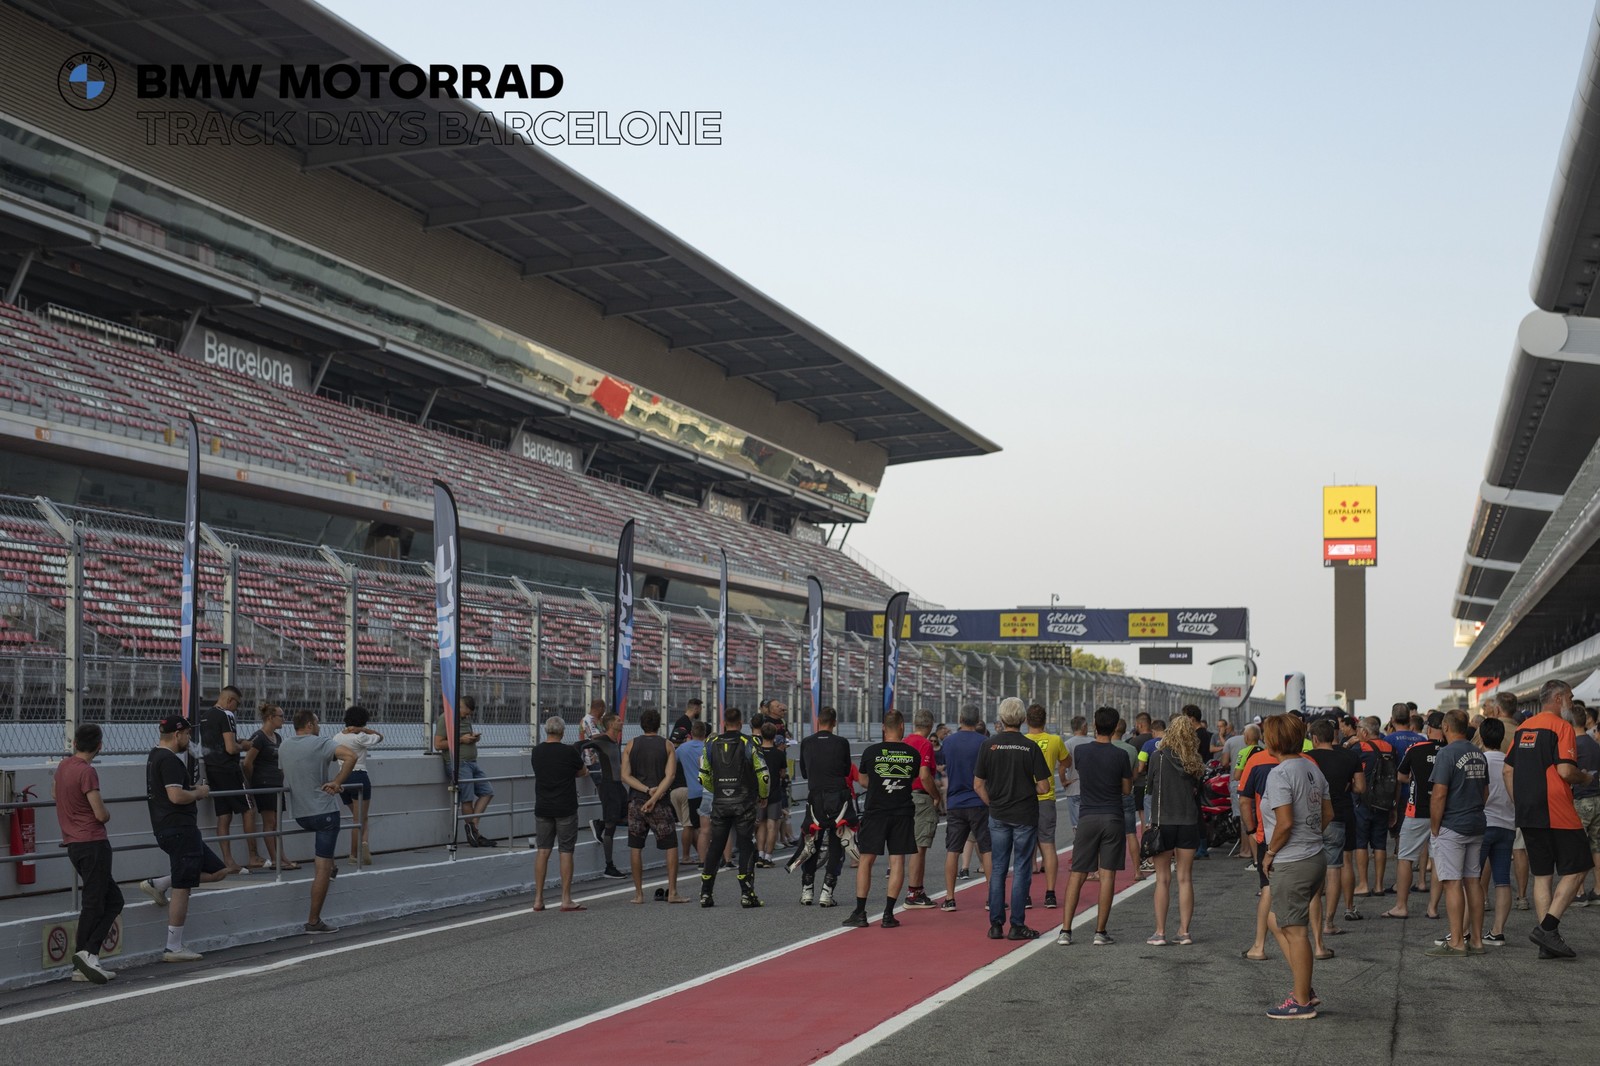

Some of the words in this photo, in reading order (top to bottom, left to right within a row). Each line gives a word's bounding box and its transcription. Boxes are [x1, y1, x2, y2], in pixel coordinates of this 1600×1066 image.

[204, 330, 293, 387] Barcelona
[522, 433, 574, 470] Barcelona
[919, 613, 958, 625] GRAND
[1047, 612, 1087, 624] GRAND
[1177, 612, 1217, 623] GRAND
[924, 625, 952, 634] TOUR
[1051, 625, 1081, 634] TOUR
[1182, 624, 1211, 633] TOUR
